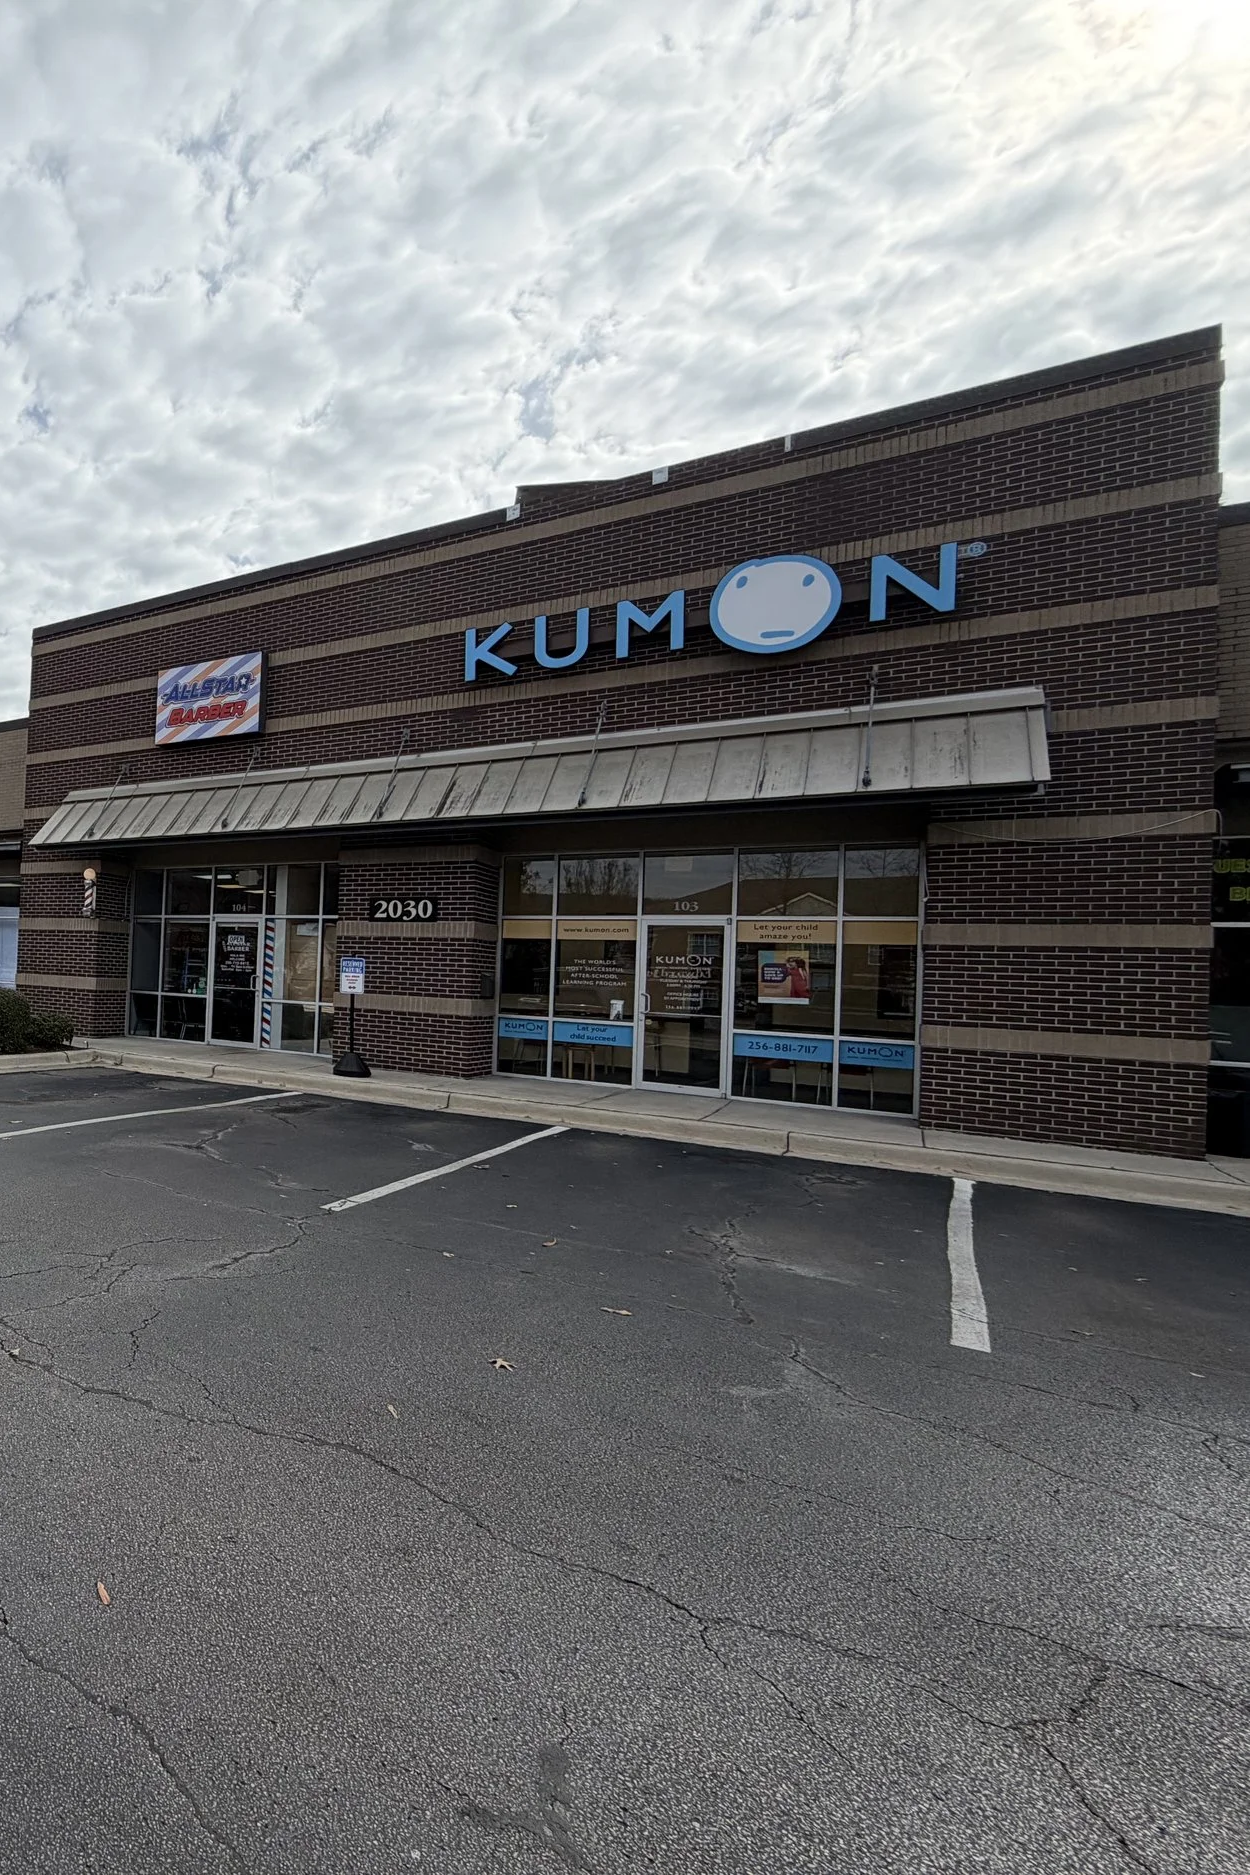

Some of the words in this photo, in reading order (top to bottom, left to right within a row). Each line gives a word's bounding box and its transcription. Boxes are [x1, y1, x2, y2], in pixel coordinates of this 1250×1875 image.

[166, 700, 248, 728] BARBER
[232, 903, 247, 912] 104
[374, 899, 433, 921] 2030
[674, 901, 699, 912] 103
[563, 926, 629, 934] www.kumon.com
[753, 923, 768, 931] Let
[795, 923, 818, 931] child
[655, 954, 712, 966] KUMON
[504, 1022, 544, 1031] KUMON
[590, 1026, 607, 1034] your
[569, 1032, 586, 1040] child
[586, 1034, 617, 1042] succeed
[748, 1041, 818, 1054] 256-881-7117
[847, 1046, 904, 1058] KUMON
